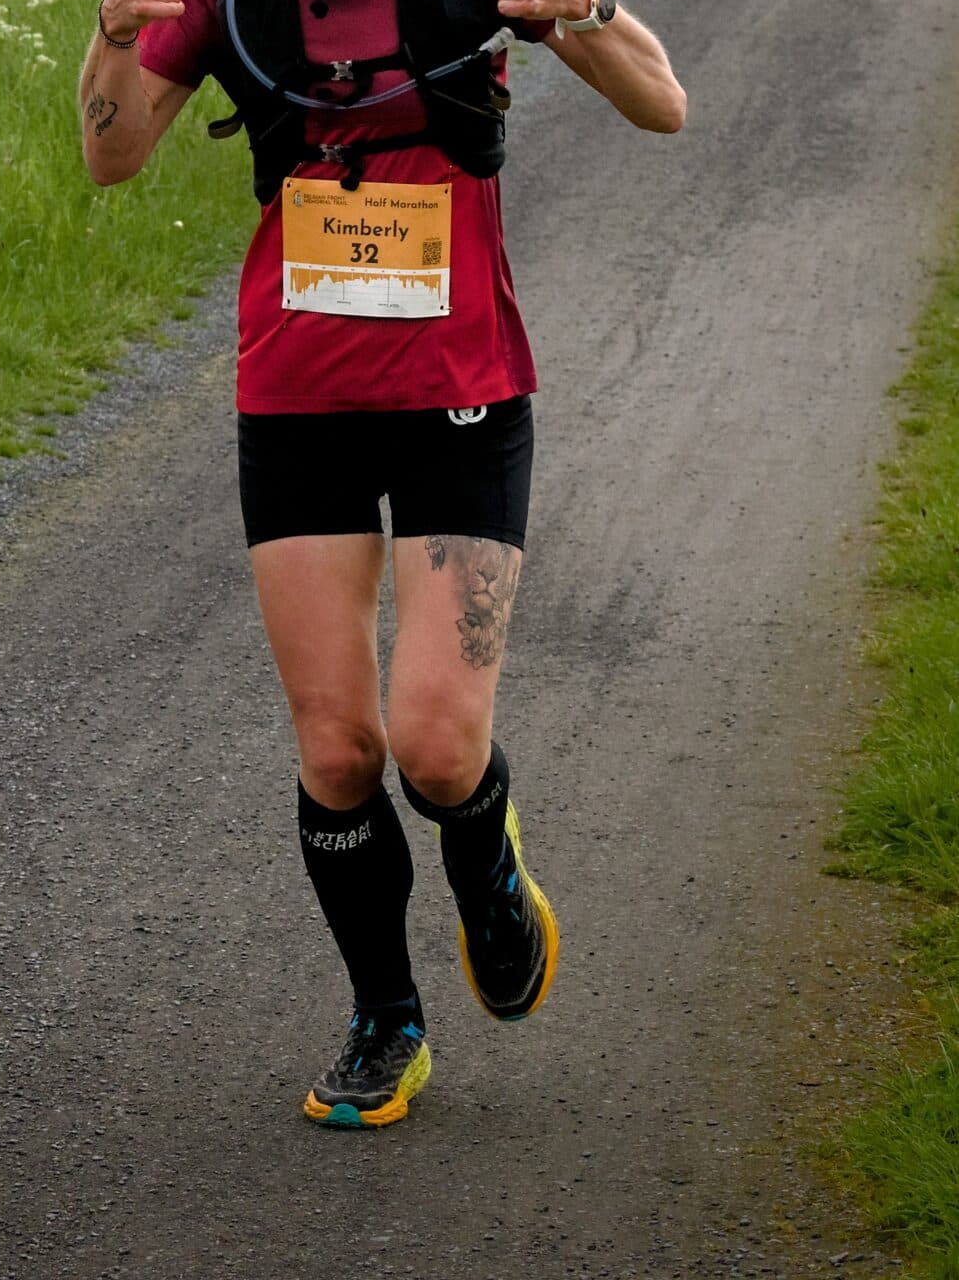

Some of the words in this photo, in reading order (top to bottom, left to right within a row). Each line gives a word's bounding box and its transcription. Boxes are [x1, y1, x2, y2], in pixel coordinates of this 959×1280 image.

[364, 197, 387, 209] Half
[390, 199, 439, 209] Marathon
[323, 217, 409, 242] Kimberly
[350, 242, 379, 264] 32
